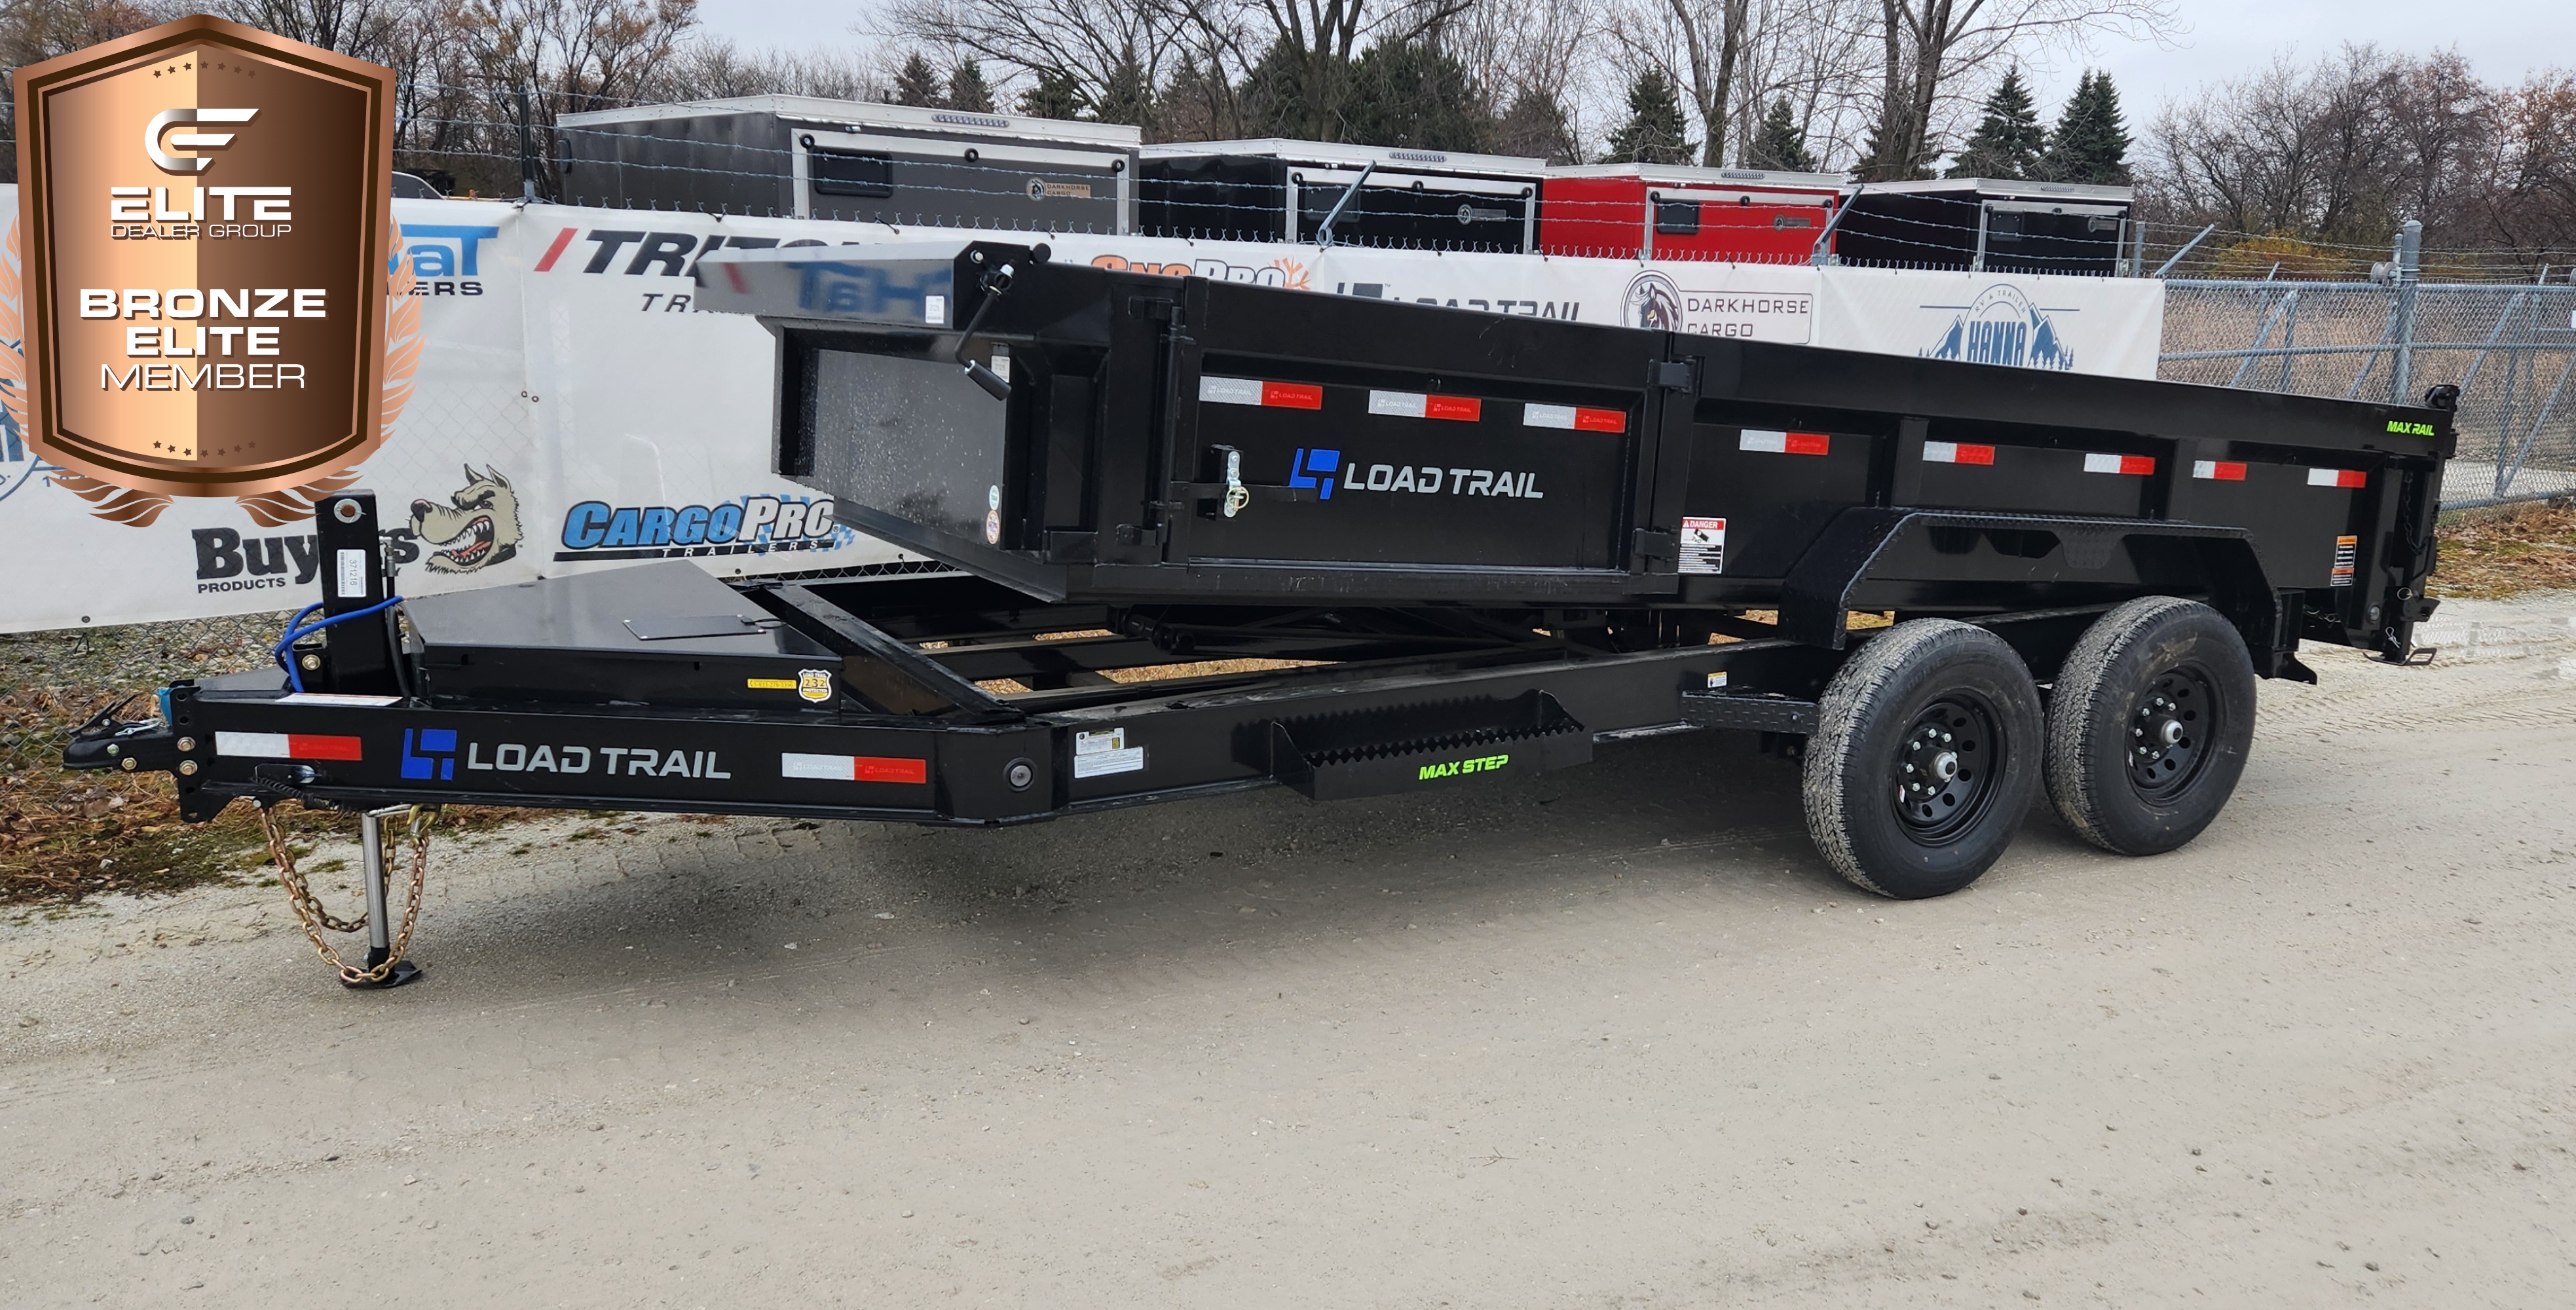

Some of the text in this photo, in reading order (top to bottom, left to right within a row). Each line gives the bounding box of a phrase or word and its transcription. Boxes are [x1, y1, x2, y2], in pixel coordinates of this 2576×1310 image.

[1687, 298, 1809, 314] DARKHORSE
[1998, 290, 2026, 314] TRAILER
[1687, 323, 1753, 337] CARGO
[1966, 320, 2027, 367] HANNA
[2386, 421, 2435, 436] MAX RAIL
[1343, 462, 1544, 499] LOAD TRAIL
[1690, 520, 1718, 529] DANGER
[661, 540, 819, 558] TRAILERS
[349, 559, 358, 586] 371216
[198, 577, 286, 594] PRODUCTS
[468, 742, 732, 779] LOAD TRAIL
[1419, 754, 1510, 780] MAX STEP
